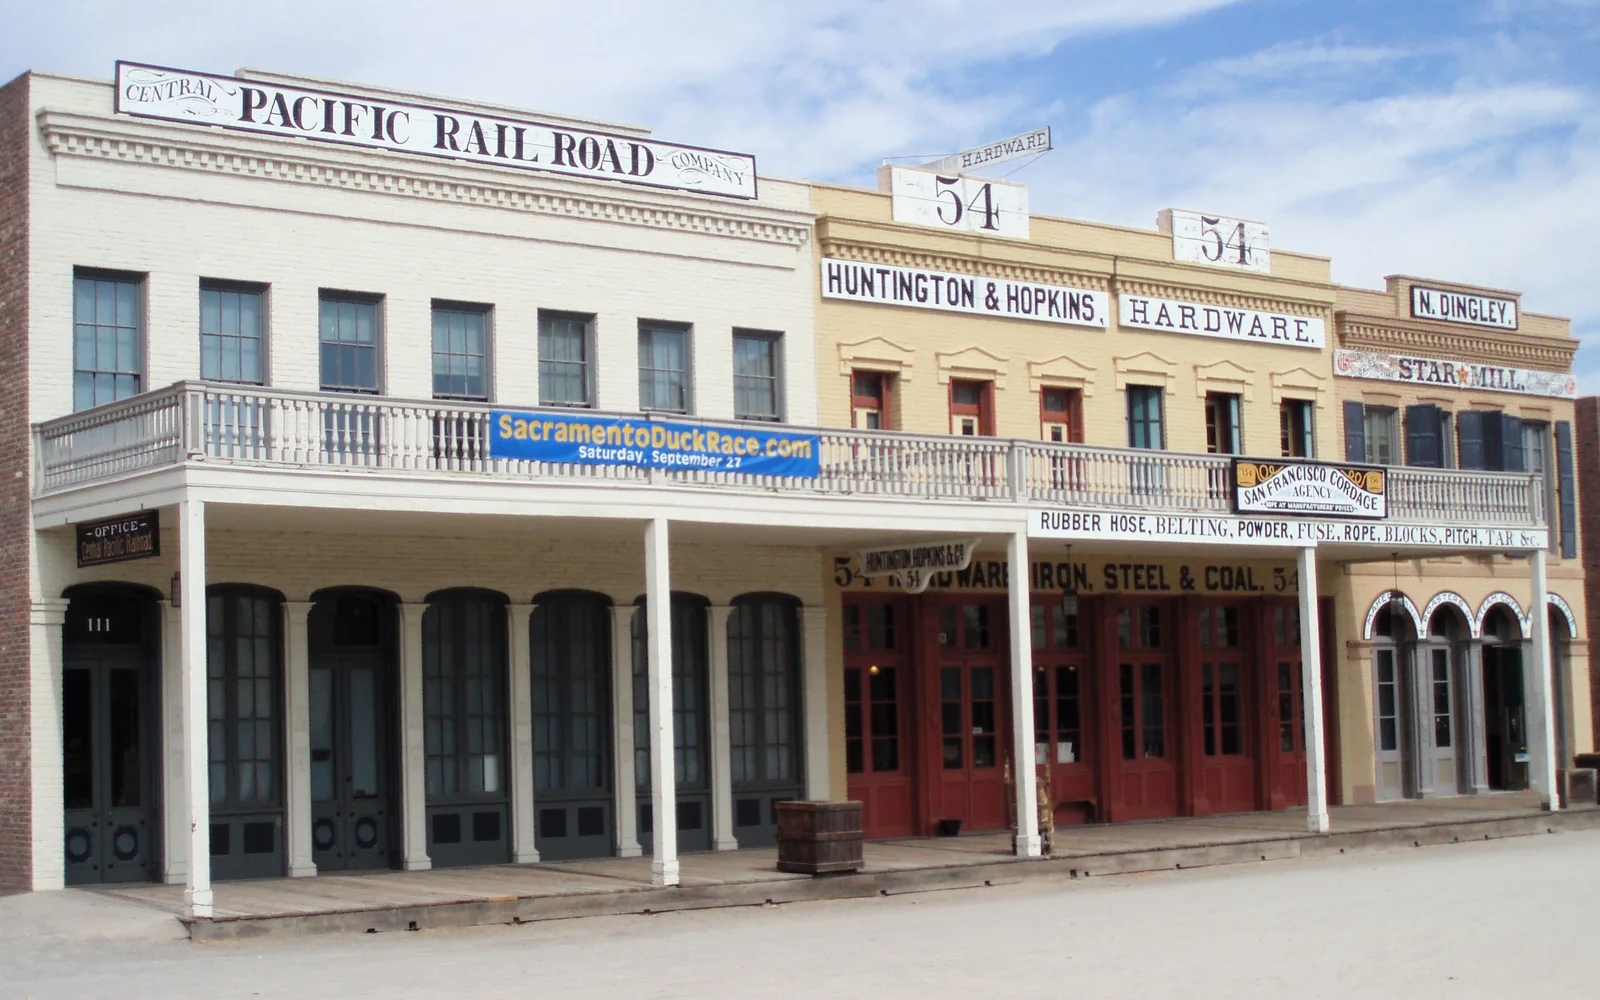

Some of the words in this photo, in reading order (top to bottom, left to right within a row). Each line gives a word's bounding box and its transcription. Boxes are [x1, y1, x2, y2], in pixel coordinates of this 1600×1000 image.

[126, 78, 218, 104] CENTRAL
[237, 85, 411, 146] PACIFIC
[433, 113, 541, 163] RAIL
[550, 131, 656, 178] ROAD
[671, 151, 745, 186] COMPANY
[961, 131, 1048, 169] HARDWARE
[935, 174, 1001, 231] 54
[1200, 216, 1253, 266] 54
[827, 263, 975, 308] HUNTINGTON
[984, 281, 1001, 312] &
[1129, 298, 1316, 344] HARDWARE.
[1419, 290, 1435, 315] N.
[1440, 293, 1512, 325] DINGLEY.
[1398, 358, 1456, 385] STAR
[1471, 364, 1526, 392] MILL.
[499, 414, 812, 459] SacramentoDuckRace.com
[578, 445, 648, 465] Saturday,
[652, 449, 723, 468] September
[726, 456, 742, 469] 27
[1243, 485, 1267, 506] SAN
[1266, 465, 1327, 497] FRANCISCO
[1329, 470, 1379, 511] CORDAGE
[1292, 484, 1333, 499] AGENCY
[94, 521, 138, 538] OFFICE
[1040, 511, 1102, 532] RUBBER
[1110, 515, 1152, 535] HOSE,
[1155, 517, 1234, 539] BELTING,
[1238, 520, 1294, 541] POWDER,
[1297, 522, 1341, 543] FUSE,
[1344, 524, 1381, 543] ROPE,
[1384, 525, 1442, 546] BLOCKS,
[1485, 529, 1514, 547] TAR
[946, 544, 954, 565] &
[906, 570, 920, 588] 54
[1103, 564, 1171, 591] STEEL
[1179, 565, 1195, 591] &
[87, 617, 111, 632] 111
